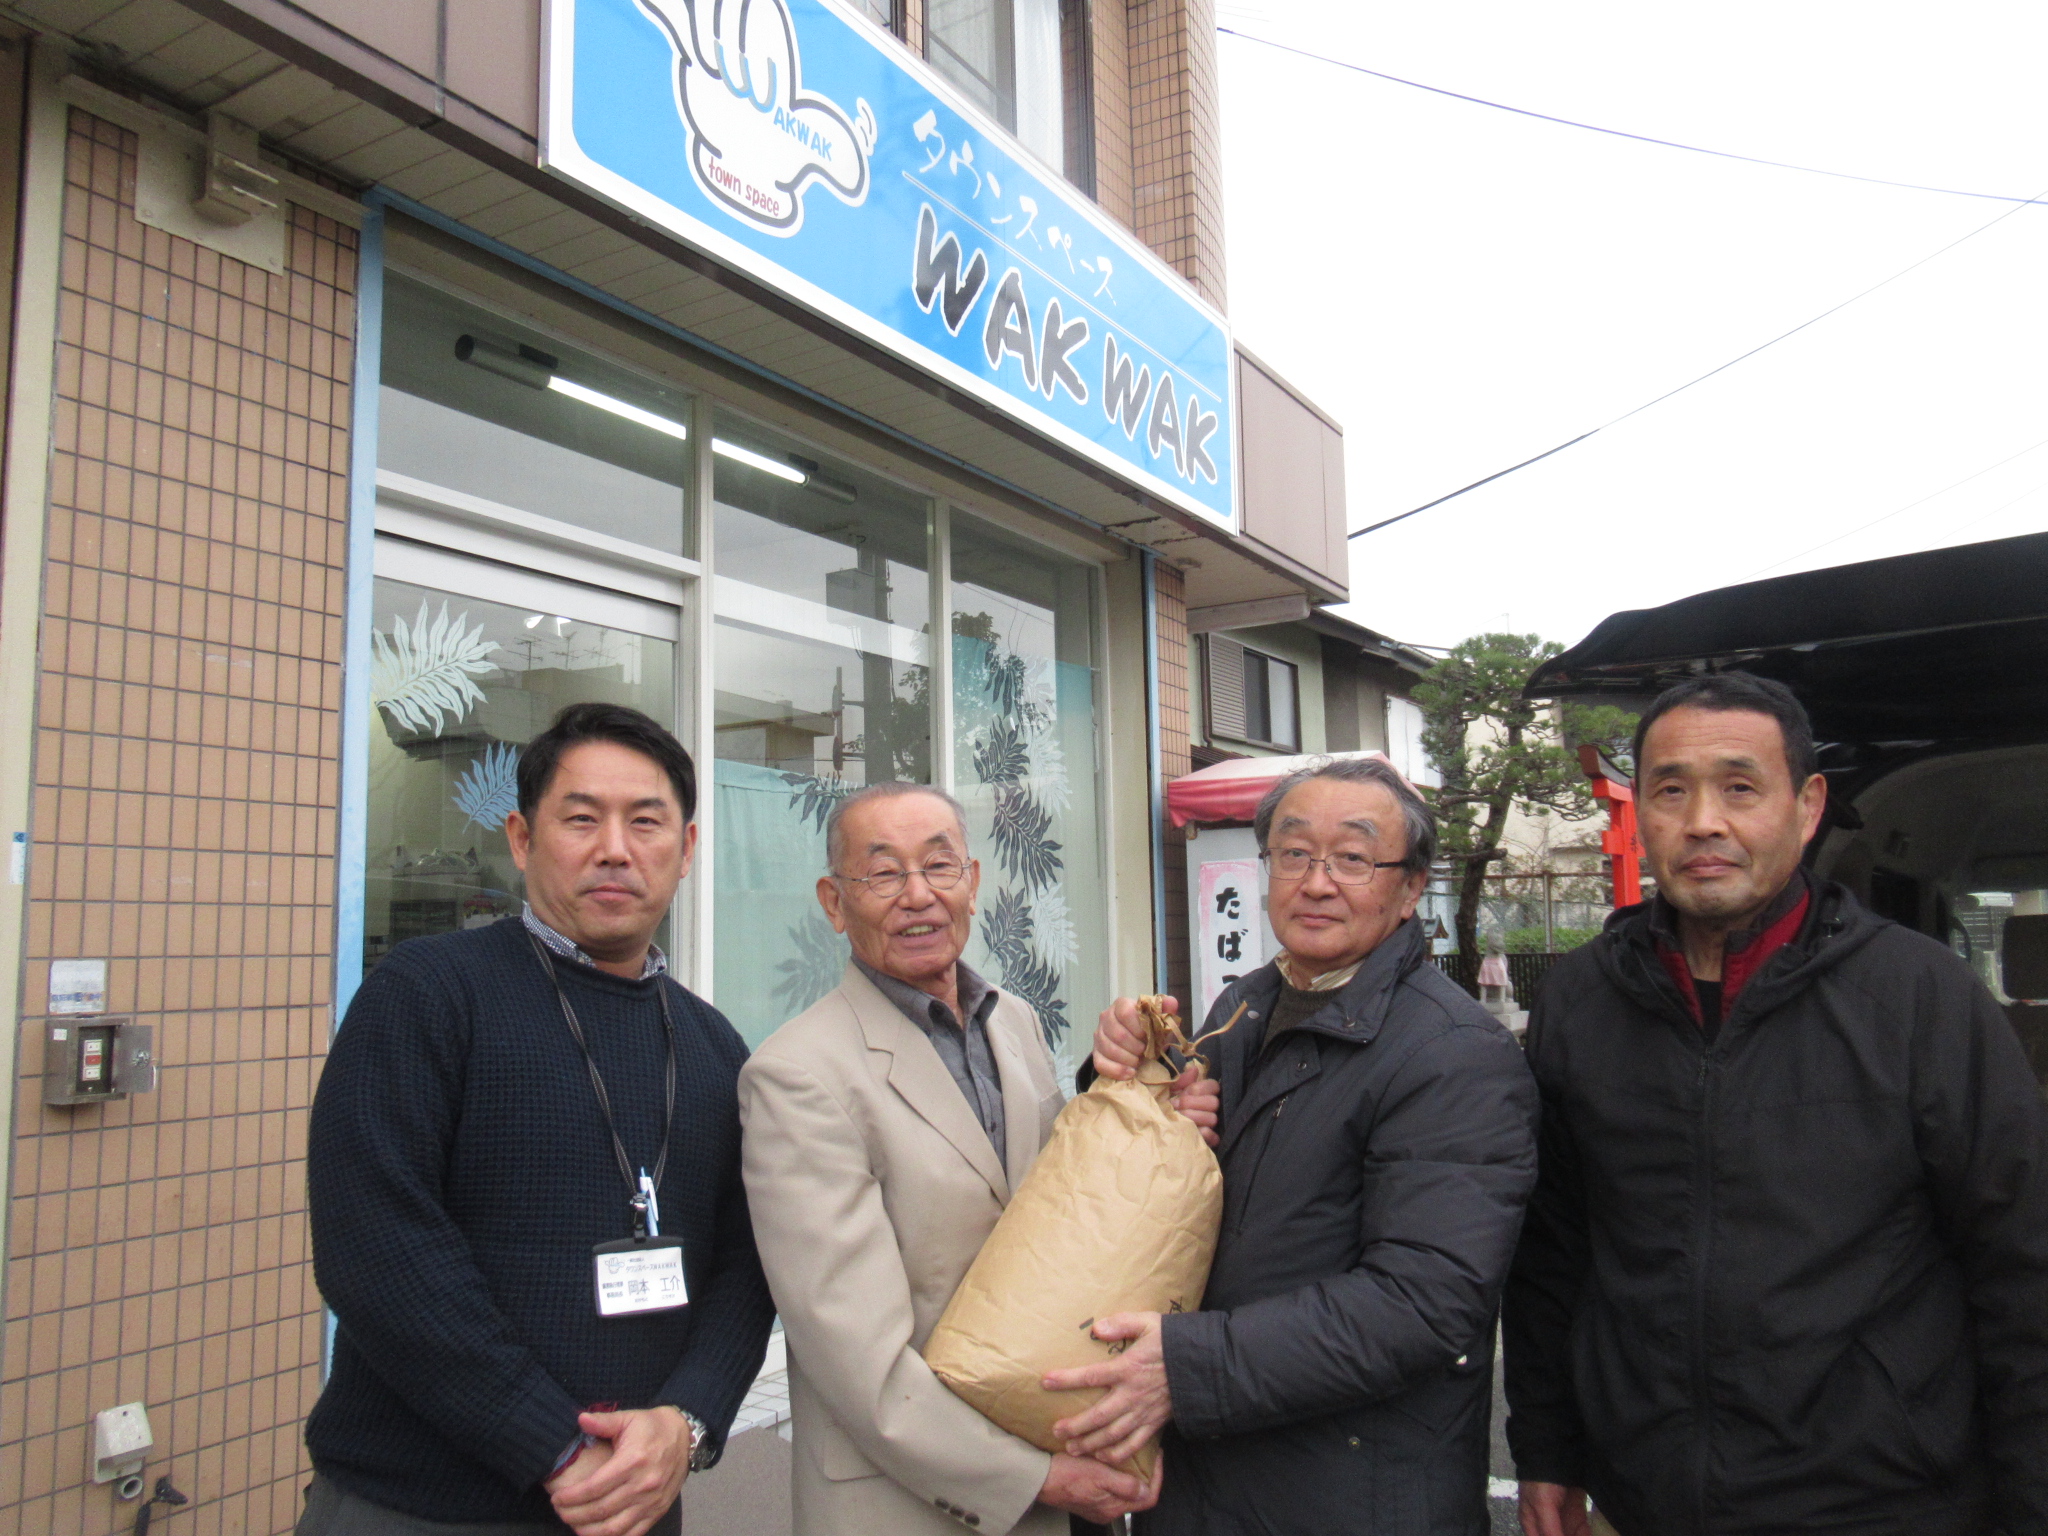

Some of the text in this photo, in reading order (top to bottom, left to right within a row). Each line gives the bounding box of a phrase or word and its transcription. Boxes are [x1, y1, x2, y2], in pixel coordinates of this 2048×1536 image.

[708, 156, 779, 217] town space
[913, 109, 1117, 306] タウンスペース
[912, 202, 1218, 485] WAK WAK
[627, 1278, 650, 1296] 岡本
[660, 1275, 681, 1292] 工介
